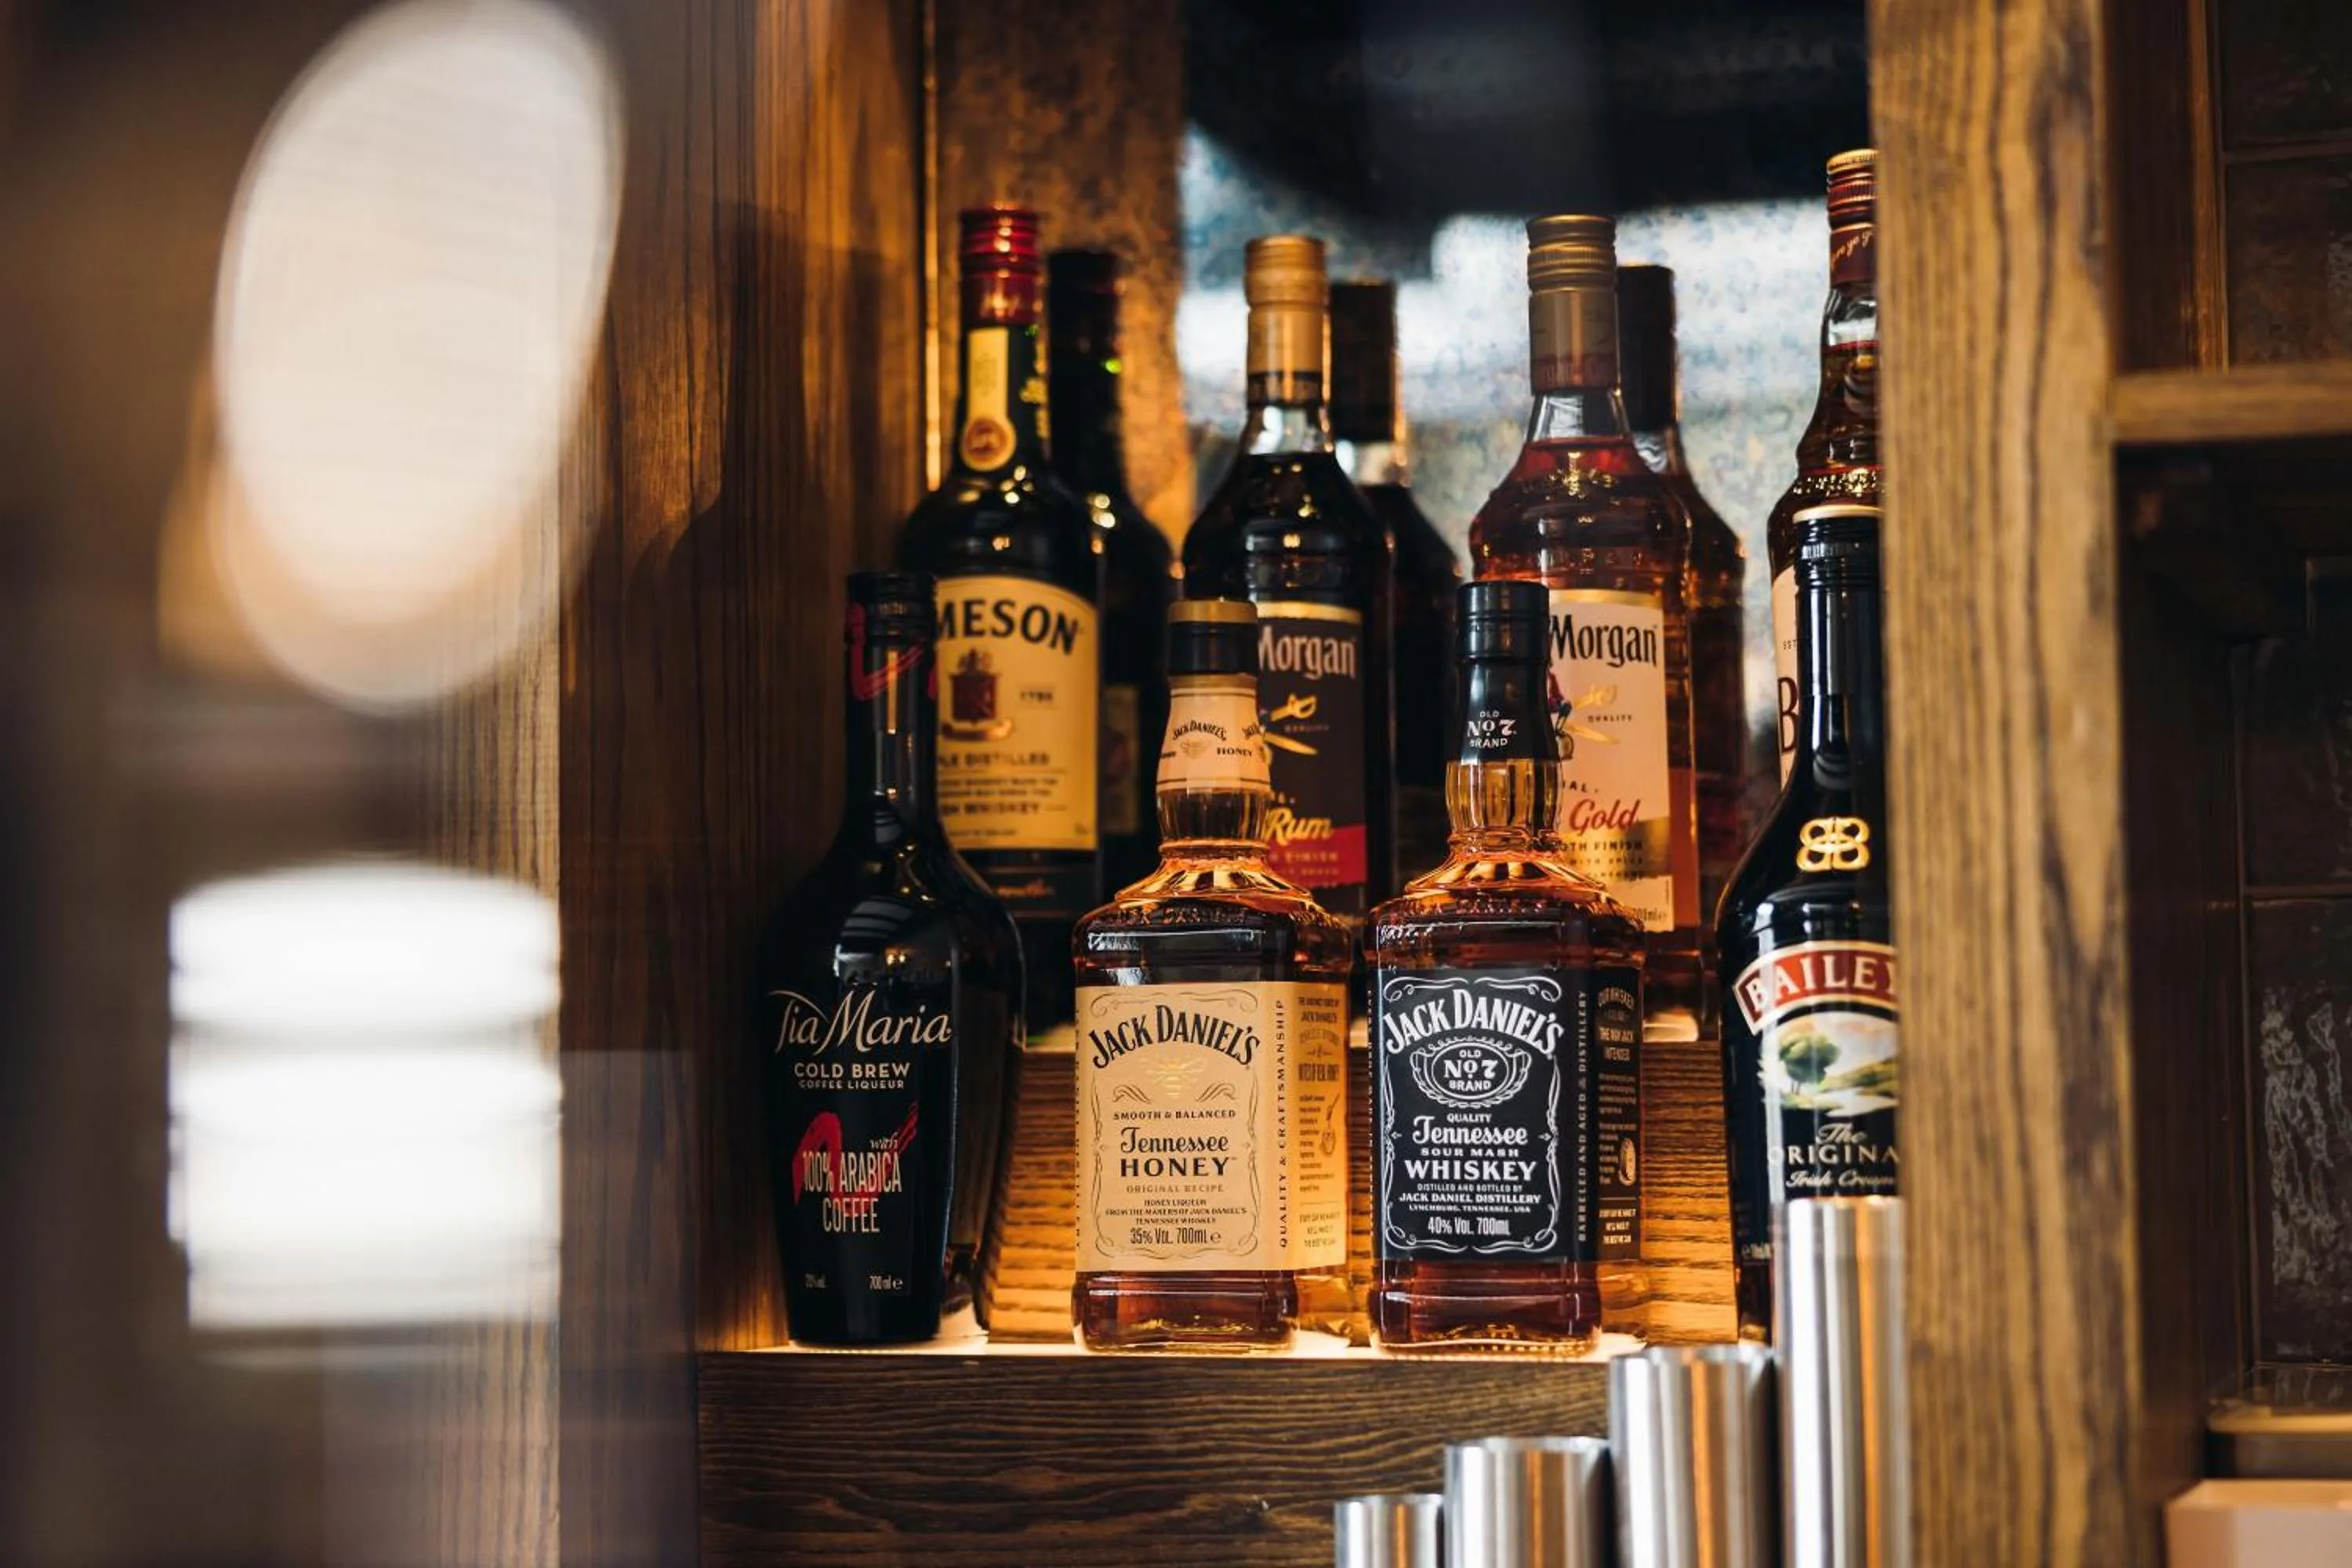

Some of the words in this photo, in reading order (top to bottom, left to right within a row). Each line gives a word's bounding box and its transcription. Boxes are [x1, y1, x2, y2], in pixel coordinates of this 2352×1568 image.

[1550, 614, 1657, 667] Morgan
[1217, 747, 1254, 757] HONEY
[1469, 738, 1508, 748] BRAND
[1263, 807, 1332, 846] Rum
[1570, 799, 1641, 836] Gold
[769, 990, 829, 1054] Tia
[813, 990, 951, 1056] Maria
[1383, 999, 1450, 1054] JACK
[1453, 989, 1564, 1055] DANIEL'S
[1577, 990, 1588, 1073] DISTILLERY
[1088, 1014, 1152, 1069] JACK
[1155, 1004, 1260, 1066] DANIEL'S
[1459, 1049, 1482, 1058] OLD
[794, 1062, 844, 1078] COLD
[851, 1062, 910, 1078] BREW
[1276, 1000, 1287, 1149] CRAFTSMANSHIP
[800, 1080, 844, 1089] COFFEE
[847, 1080, 904, 1089] LIQUEUR
[1449, 1080, 1491, 1091] BRAND
[1113, 1110, 1161, 1121] SMOOTH
[1164, 1111, 1173, 1120] &
[1175, 1109, 1236, 1120] BALANCED
[1446, 1113, 1492, 1123] QUALITY
[1577, 1094, 1587, 1131] AGED
[1120, 1127, 1229, 1153] Tennessee
[1412, 1115, 1528, 1145] Tennessee
[1816, 1123, 1867, 1144] The
[1421, 1148, 1464, 1156] SOUR
[1470, 1148, 1519, 1157] MASH
[1577, 1134, 1587, 1163] AND
[803, 1151, 835, 1192] 100%
[839, 1152, 902, 1192] ARABICA
[1120, 1156, 1229, 1178] HONEY
[1404, 1160, 1537, 1181] WHISKEY
[1127, 1185, 1179, 1193] ORIGINAL
[1184, 1184, 1224, 1192] RECIPE
[1476, 1184, 1511, 1192] BOTTLED
[1786, 1171, 1832, 1187] Irish
[1399, 1193, 1428, 1203] JACK
[1431, 1193, 1473, 1203] DANIEL
[1475, 1194, 1541, 1204] DISTILLERY
[1577, 1167, 1587, 1242] BARRELED
[822, 1198, 880, 1232] COFFEE
[1279, 1174, 1288, 1247] QUALITY
[1130, 1227, 1153, 1244] 35%
[1428, 1216, 1452, 1235] 40%
